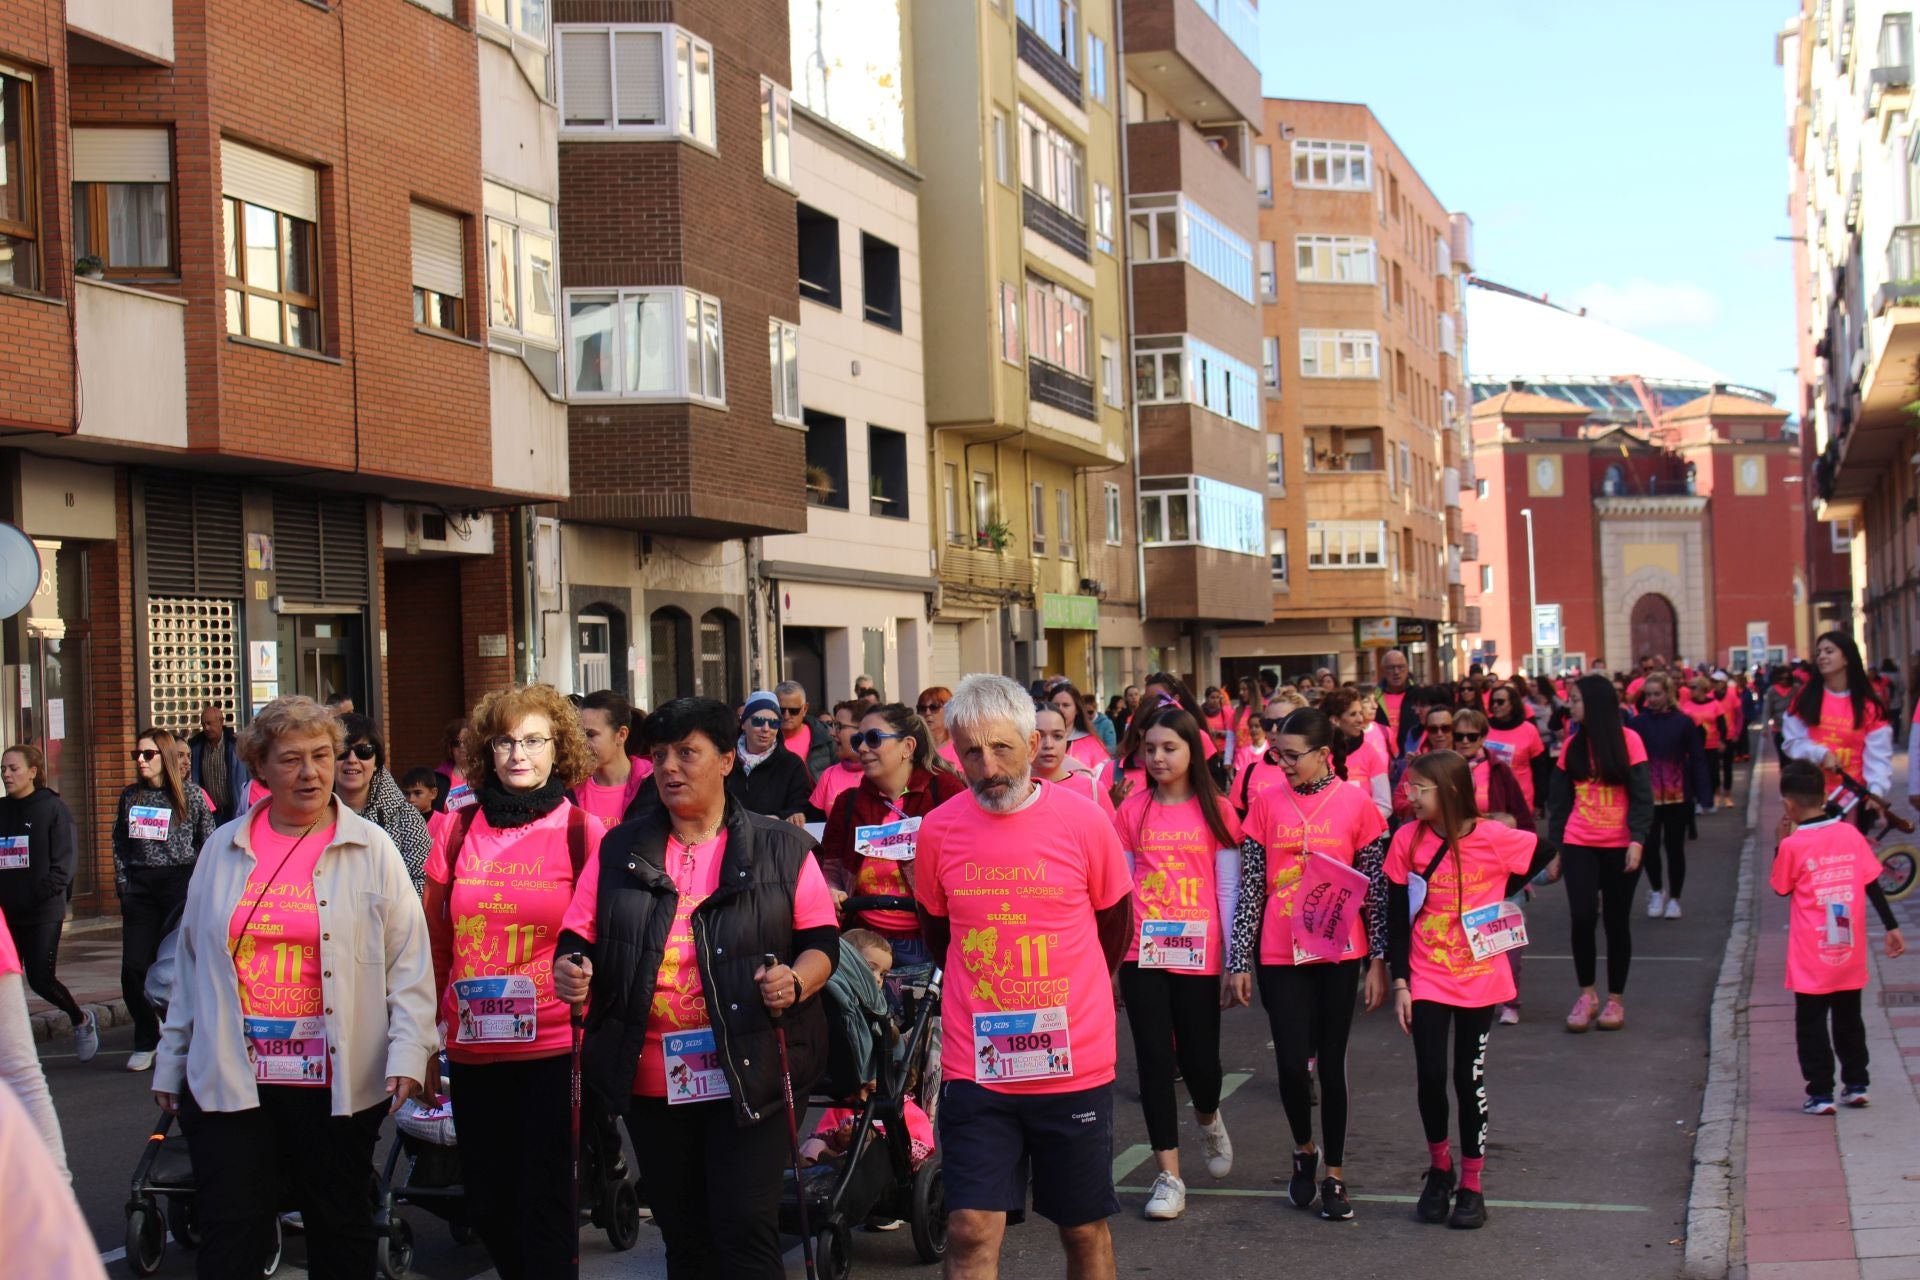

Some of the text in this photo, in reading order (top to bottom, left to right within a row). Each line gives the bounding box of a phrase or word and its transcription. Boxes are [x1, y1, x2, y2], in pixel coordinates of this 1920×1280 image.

[65, 491, 75, 508] 18
[256, 582, 268, 599] 18
[880, 834, 913, 847] 4284
[511, 879, 559, 890] CAROBELS
[1015, 886, 1064, 896] CAROBELS
[279, 900, 318, 911] CAROBEL
[478, 902, 517, 910] SUZUKI
[986, 913, 1027, 921] SUZUKI
[1322, 887, 1353, 941] Ezedent
[246, 922, 284, 932] SUZUKI
[1487, 918, 1509, 934] 1571
[671, 934, 695, 943] SUZ
[1163, 936, 1194, 948] 4515
[483, 959, 551, 978] Carrera
[251, 982, 321, 1001] Carrera
[1000, 977, 1070, 995] Carrera
[480, 999, 515, 1015] 1812
[1001, 997, 1012, 1005] de
[1020, 991, 1070, 1009] Mujer
[269, 1000, 321, 1017] Mujer
[263, 1039, 305, 1055] 1810
[1006, 1032, 1052, 1053] 1809
[700, 1053, 718, 1069] 18
